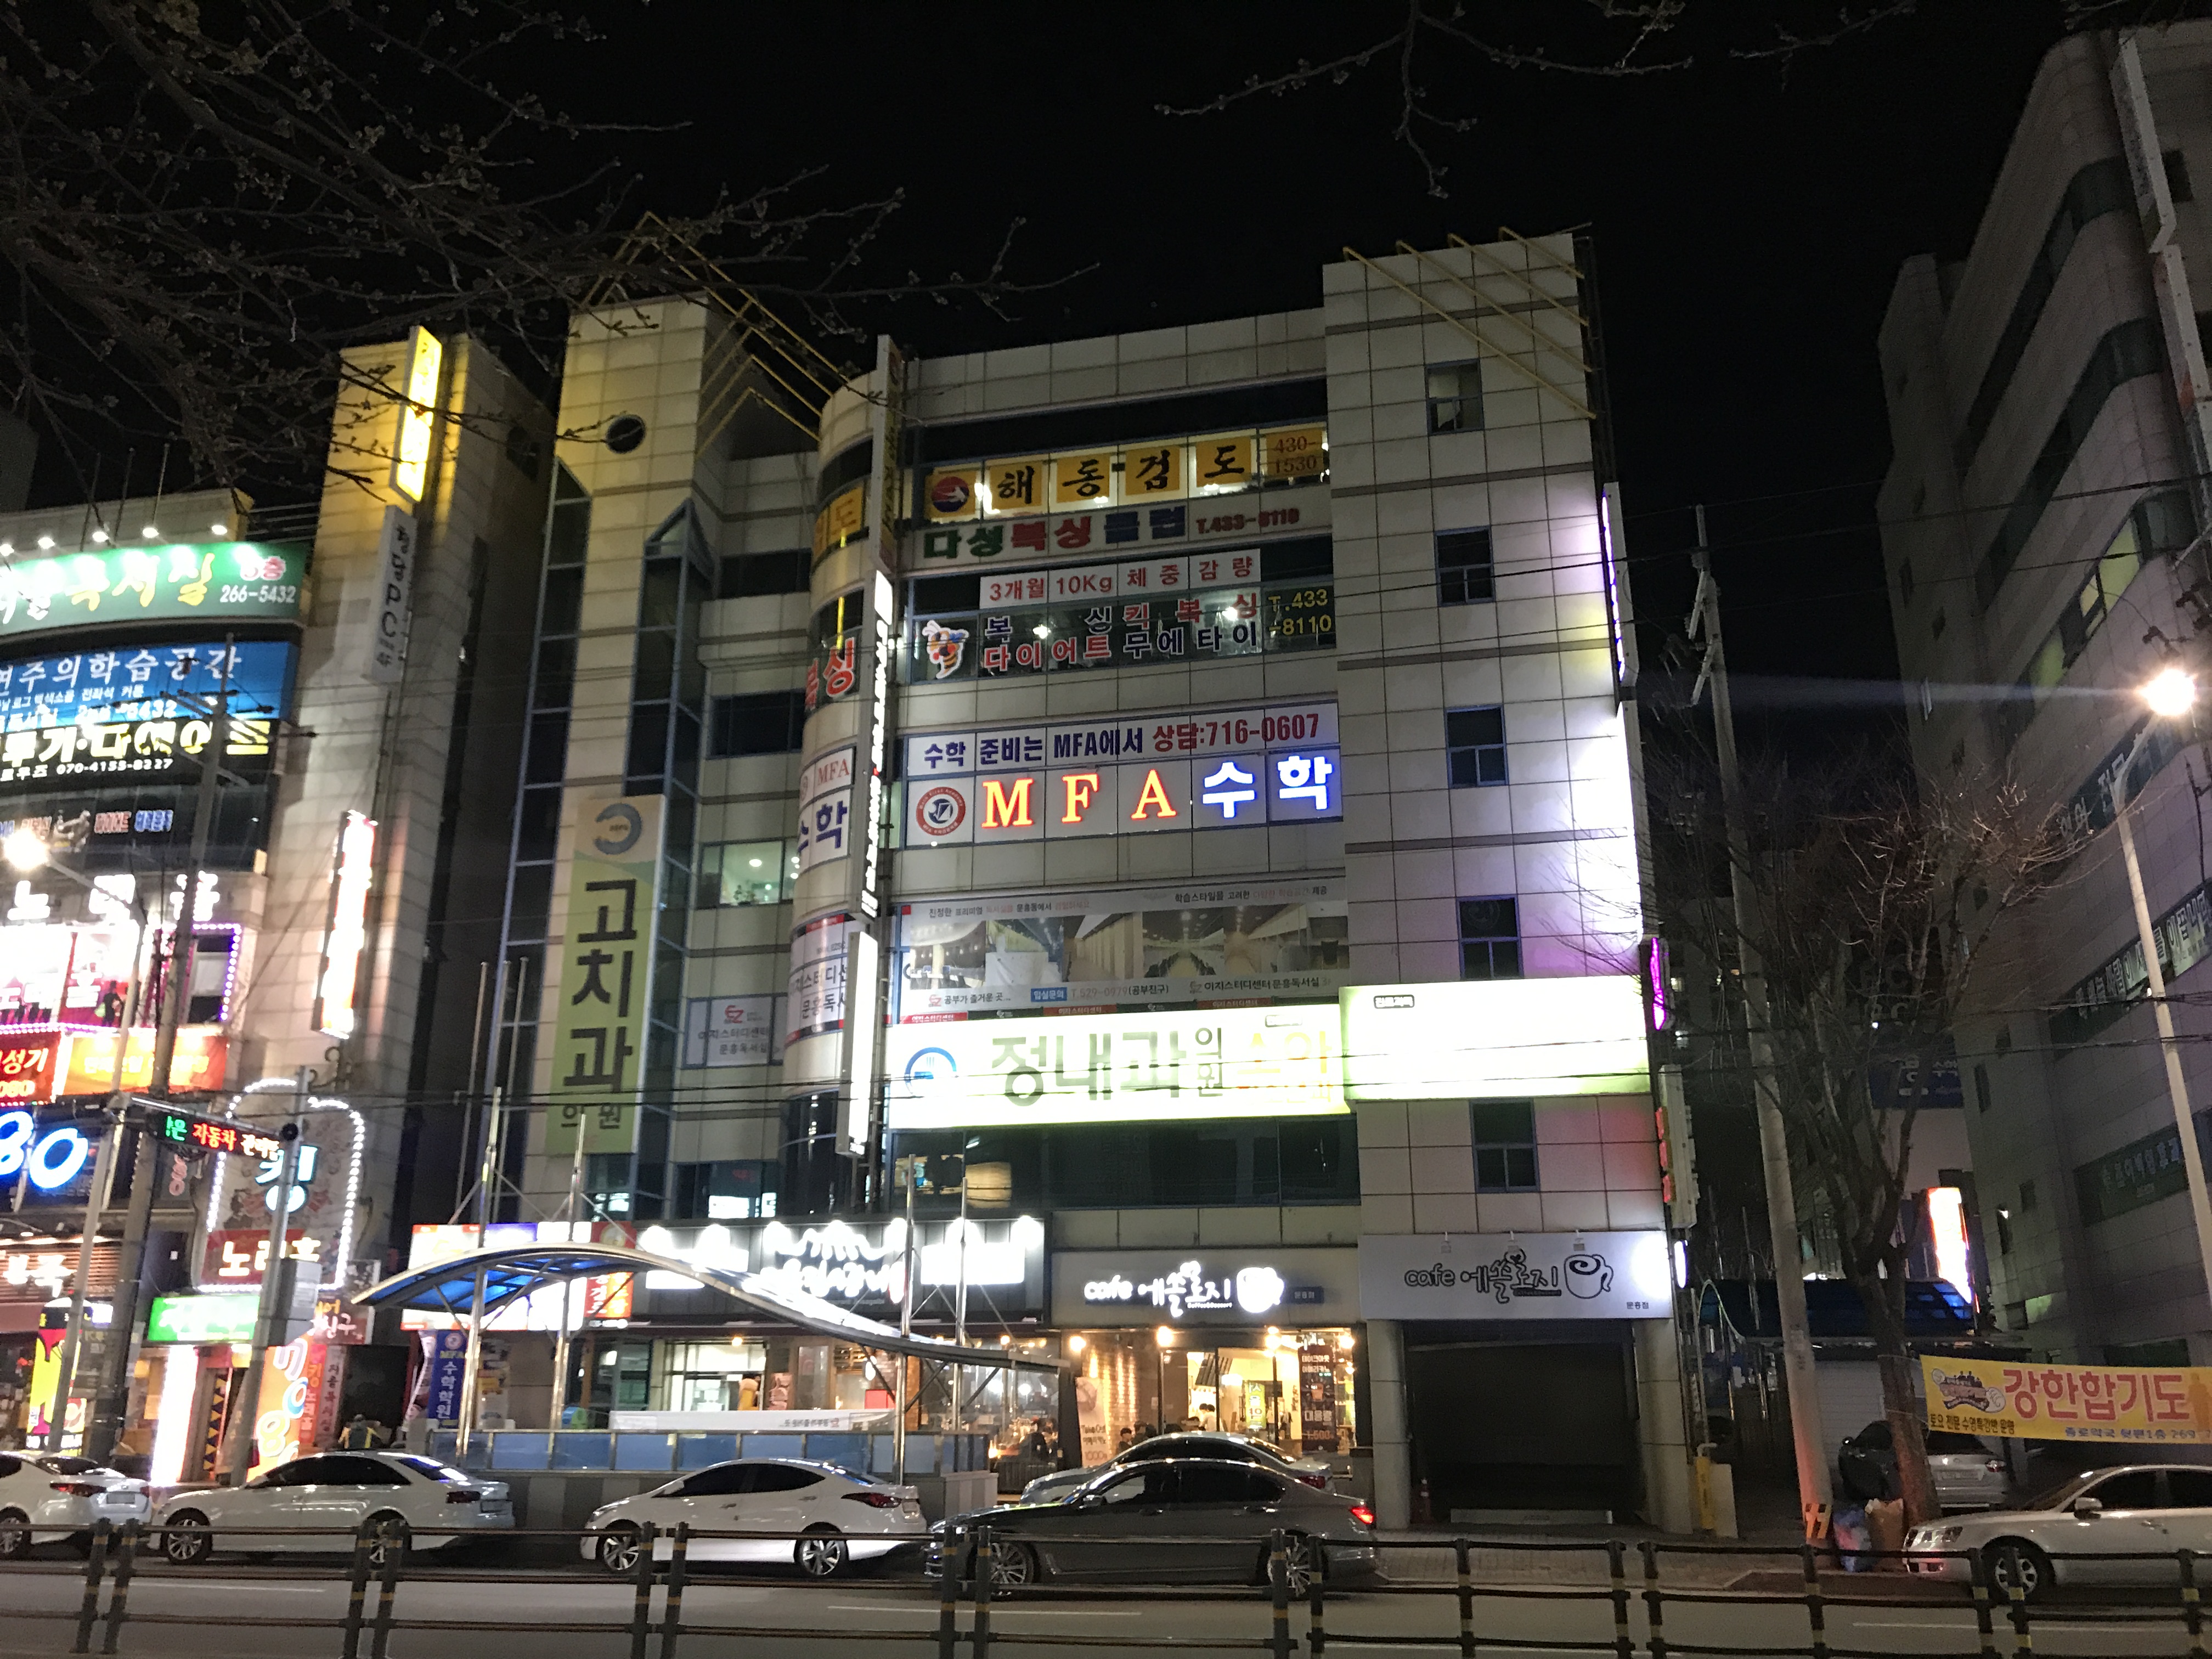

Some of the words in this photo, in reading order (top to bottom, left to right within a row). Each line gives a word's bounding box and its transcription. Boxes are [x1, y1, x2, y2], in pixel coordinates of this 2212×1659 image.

[998, 445, 1245, 504] 해동검도
[1273, 455, 1317, 475] 1530
[989, 578, 1045, 601] 3개월
[1057, 574, 1113, 595] 10Kg
[1127, 564, 1180, 588] 체중
[1199, 556, 1253, 582] 감량
[220, 584, 296, 603] 266-5432
[1268, 589, 1329, 612] T.433
[1268, 614, 1333, 636] -8110
[983, 634, 1112, 672] 다이어트
[1123, 622, 1257, 659] 무에타이
[924, 741, 966, 769] 수학
[980, 737, 1043, 765] 준비는
[1053, 727, 1143, 758] MFA에서
[1153, 713, 1319, 753] 상담:716-0607
[56, 758, 174, 775] 070-4155-8227
[817, 759, 849, 786] MFA
[980, 769, 1178, 830] MFA
[1202, 755, 1335, 819] 수학
[561, 879, 637, 1094] 고치과
[1204, 979, 1271, 991] 이지스터디센터
[1272, 977, 1319, 989] 문흥독서실
[944, 995, 968, 1005] 공부가
[992, 1031, 1186, 1107] 정내과
[1195, 1028, 1223, 1097] 의원
[561, 1101, 620, 1130] 의원
[193, 1122, 237, 1152] 자동차
[1084, 1274, 1133, 1300] cafe
[1404, 1263, 1455, 1287] cafe
[1626, 1301, 1649, 1310] 문흥점
[2003, 1368, 2190, 1423] 강한합기도
[1305, 1410, 1333, 1422] 대용량
